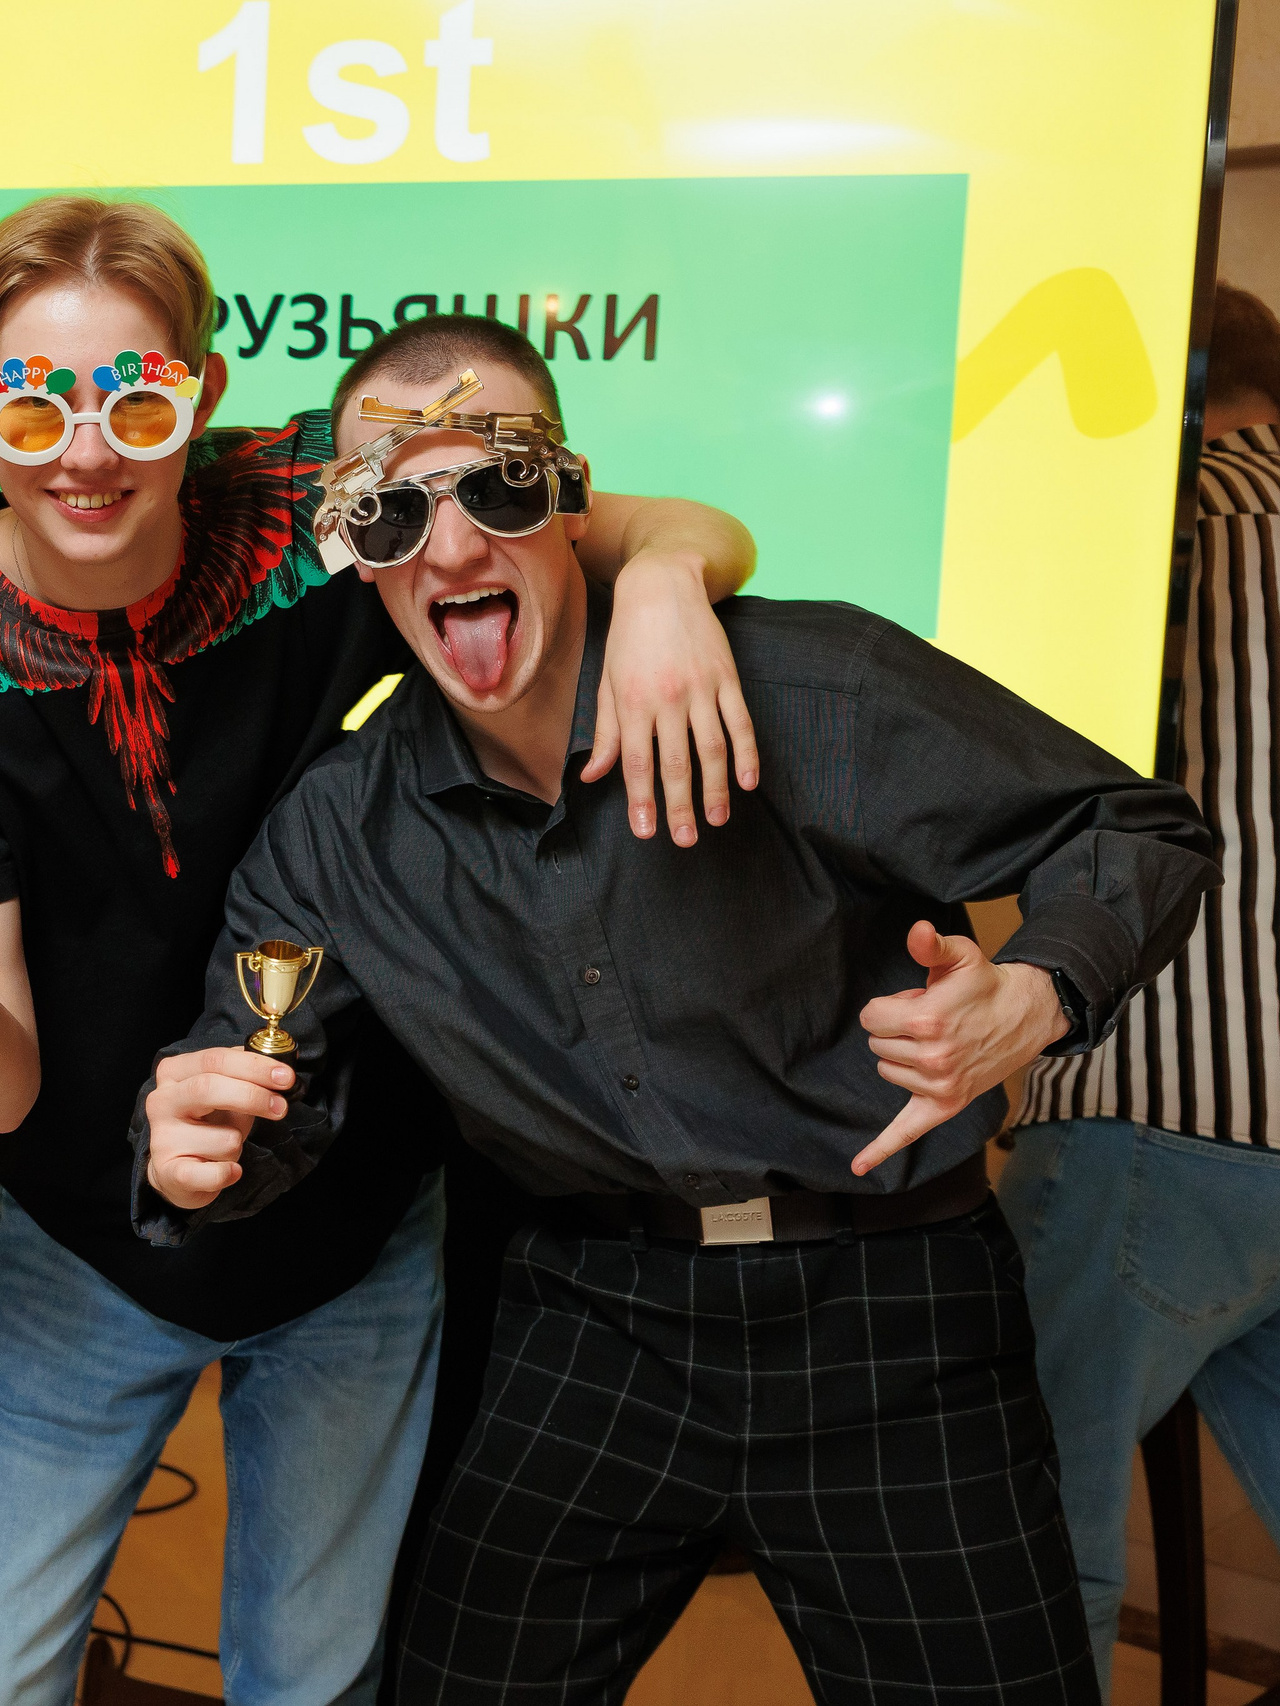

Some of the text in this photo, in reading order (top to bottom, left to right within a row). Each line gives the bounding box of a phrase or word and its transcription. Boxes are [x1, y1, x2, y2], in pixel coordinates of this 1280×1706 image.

[198, 0, 493, 164] 1st
[111, 362, 188, 386] BIRTHDAY
[711, 1211, 762, 1222] LACOSTE
